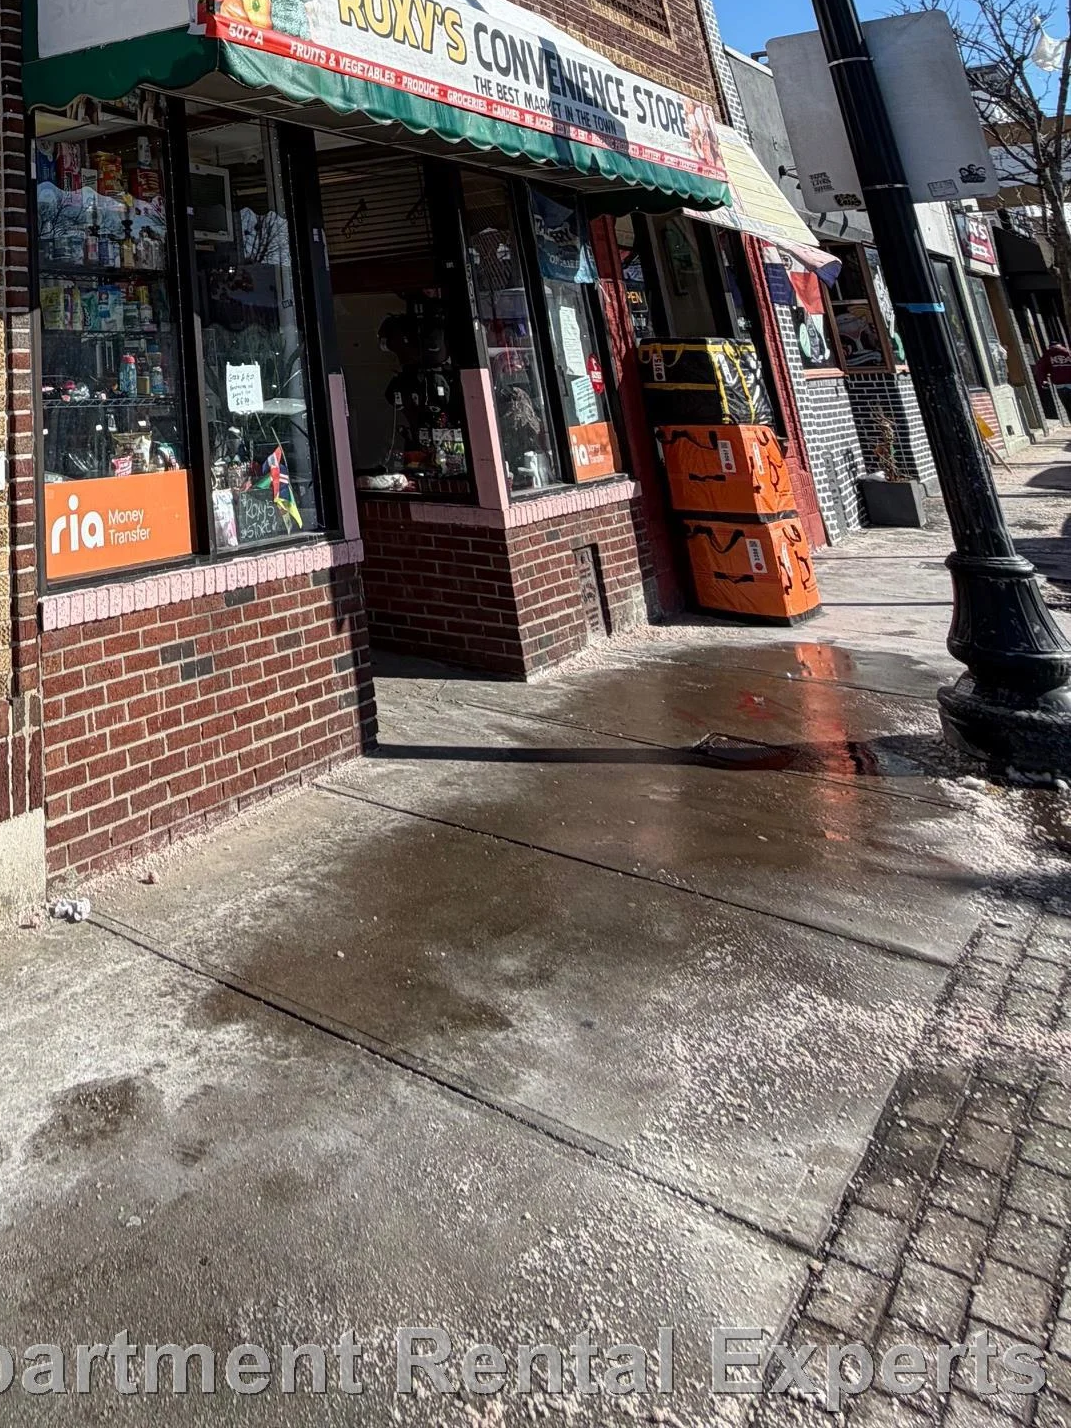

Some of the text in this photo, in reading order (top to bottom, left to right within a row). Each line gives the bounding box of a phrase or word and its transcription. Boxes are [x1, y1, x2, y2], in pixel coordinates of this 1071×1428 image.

[227, 23, 264, 46] 507-A
[290, 41, 327, 63] FRUITS
[329, 53, 337, 67] &
[339, 56, 397, 85] VEGETABLES
[401, 75, 440, 98] PRODUCE
[447, 88, 488, 112] GROCERIES
[492, 103, 521, 122] CANDIES
[524, 113, 535, 127] WE
[473, 74, 493, 97] THE
[497, 83, 520, 105] BEST
[524, 92, 561, 119] MARKET
[565, 107, 574, 122] IN
[576, 109, 592, 128] THE
[593, 114, 618, 136] TOWN
[474, 21, 630, 119] CONVENIENCE
[633, 84, 691, 139] STORE
[571, 434, 589, 467] ia
[51, 493, 144, 555] ria Money
[109, 525, 151, 546] Transfer
